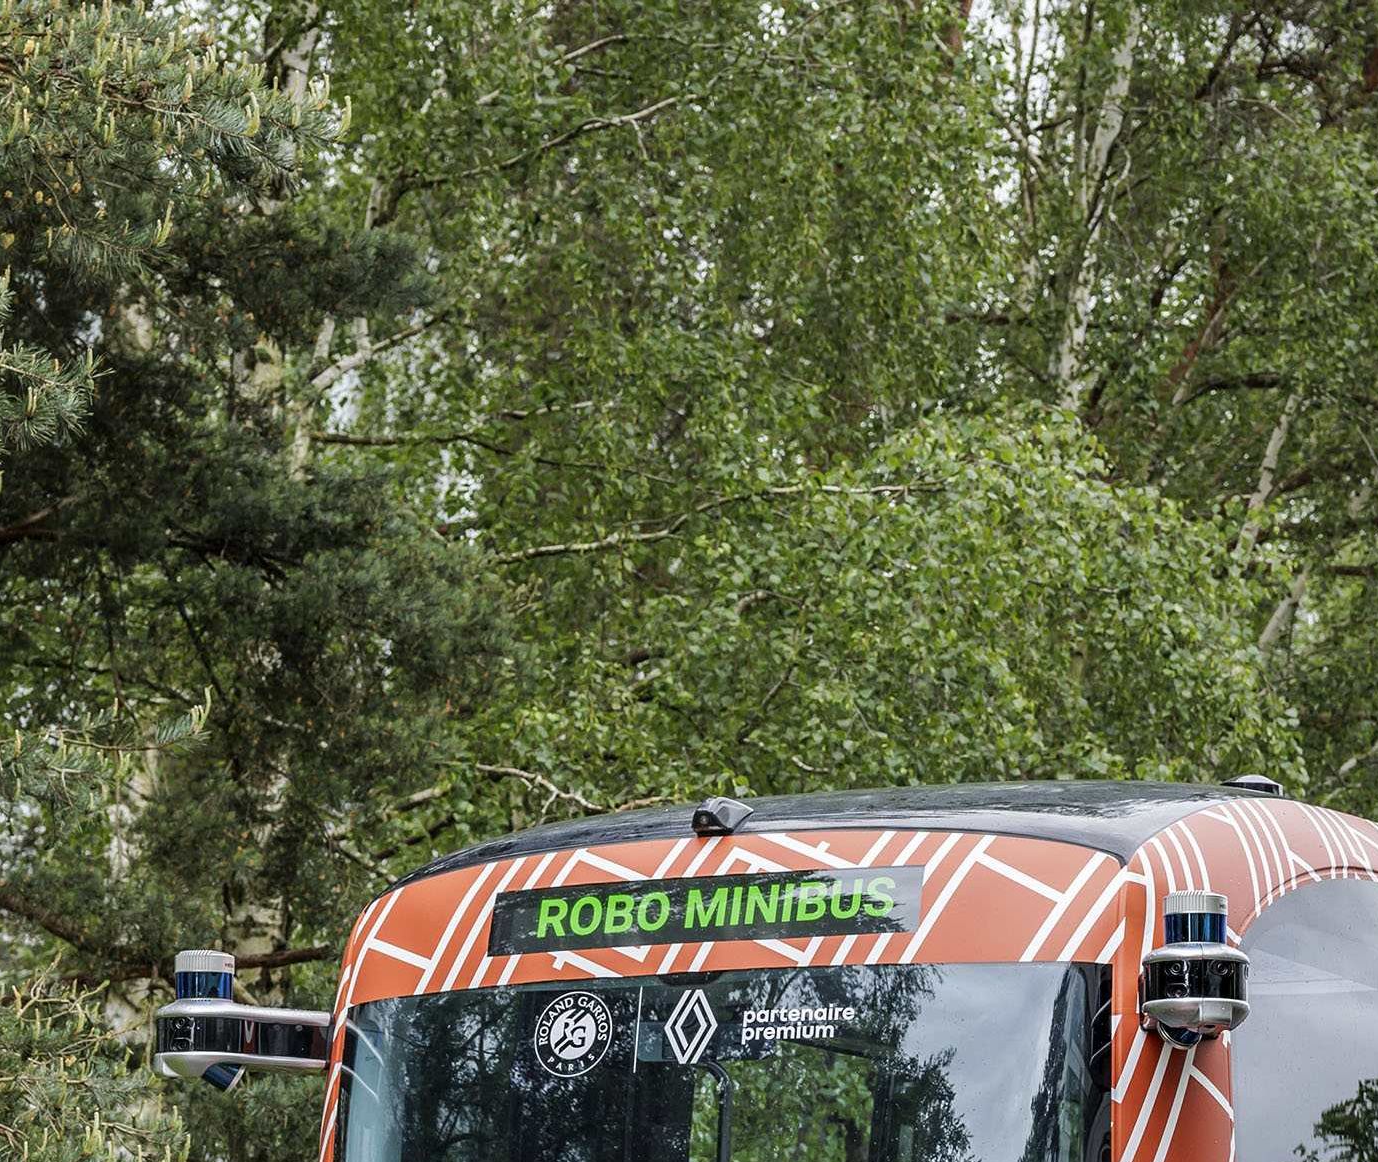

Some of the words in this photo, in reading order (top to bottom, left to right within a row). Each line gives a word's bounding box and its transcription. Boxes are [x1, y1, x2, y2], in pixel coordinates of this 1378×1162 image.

[536, 891, 670, 938] ROBO
[684, 876, 895, 928] MINIBUS
[539, 997, 574, 1046] ROLAND
[577, 996, 608, 1041] GARROS
[743, 1003, 855, 1027] partenaire
[741, 1021, 835, 1045] premium
[547, 1053, 596, 1072] PARIS
